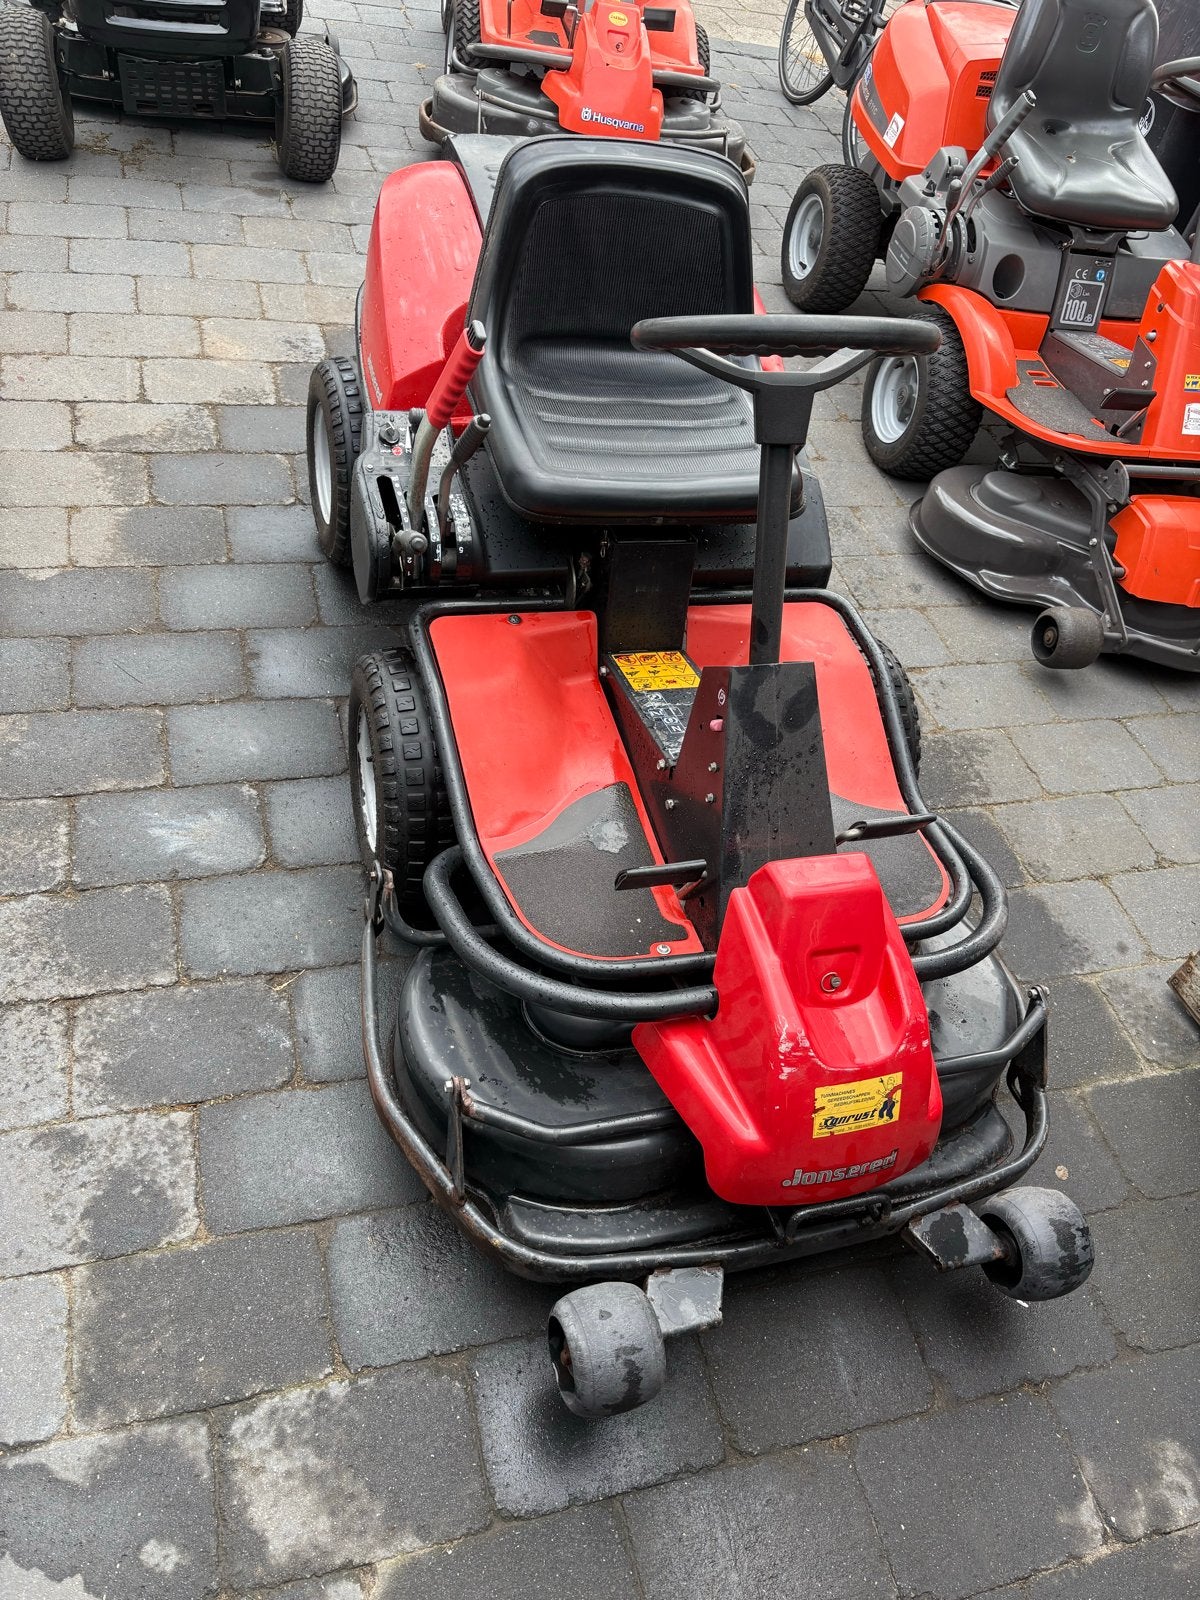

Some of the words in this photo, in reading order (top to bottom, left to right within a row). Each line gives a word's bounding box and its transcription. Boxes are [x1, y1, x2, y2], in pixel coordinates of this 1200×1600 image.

[592, 111, 645, 133] Husqvarna
[1075, 268, 1089, 280] CE
[1064, 299, 1088, 322] 100
[1084, 313, 1093, 323] dB
[782, 1149, 899, 1187] Jonsered
